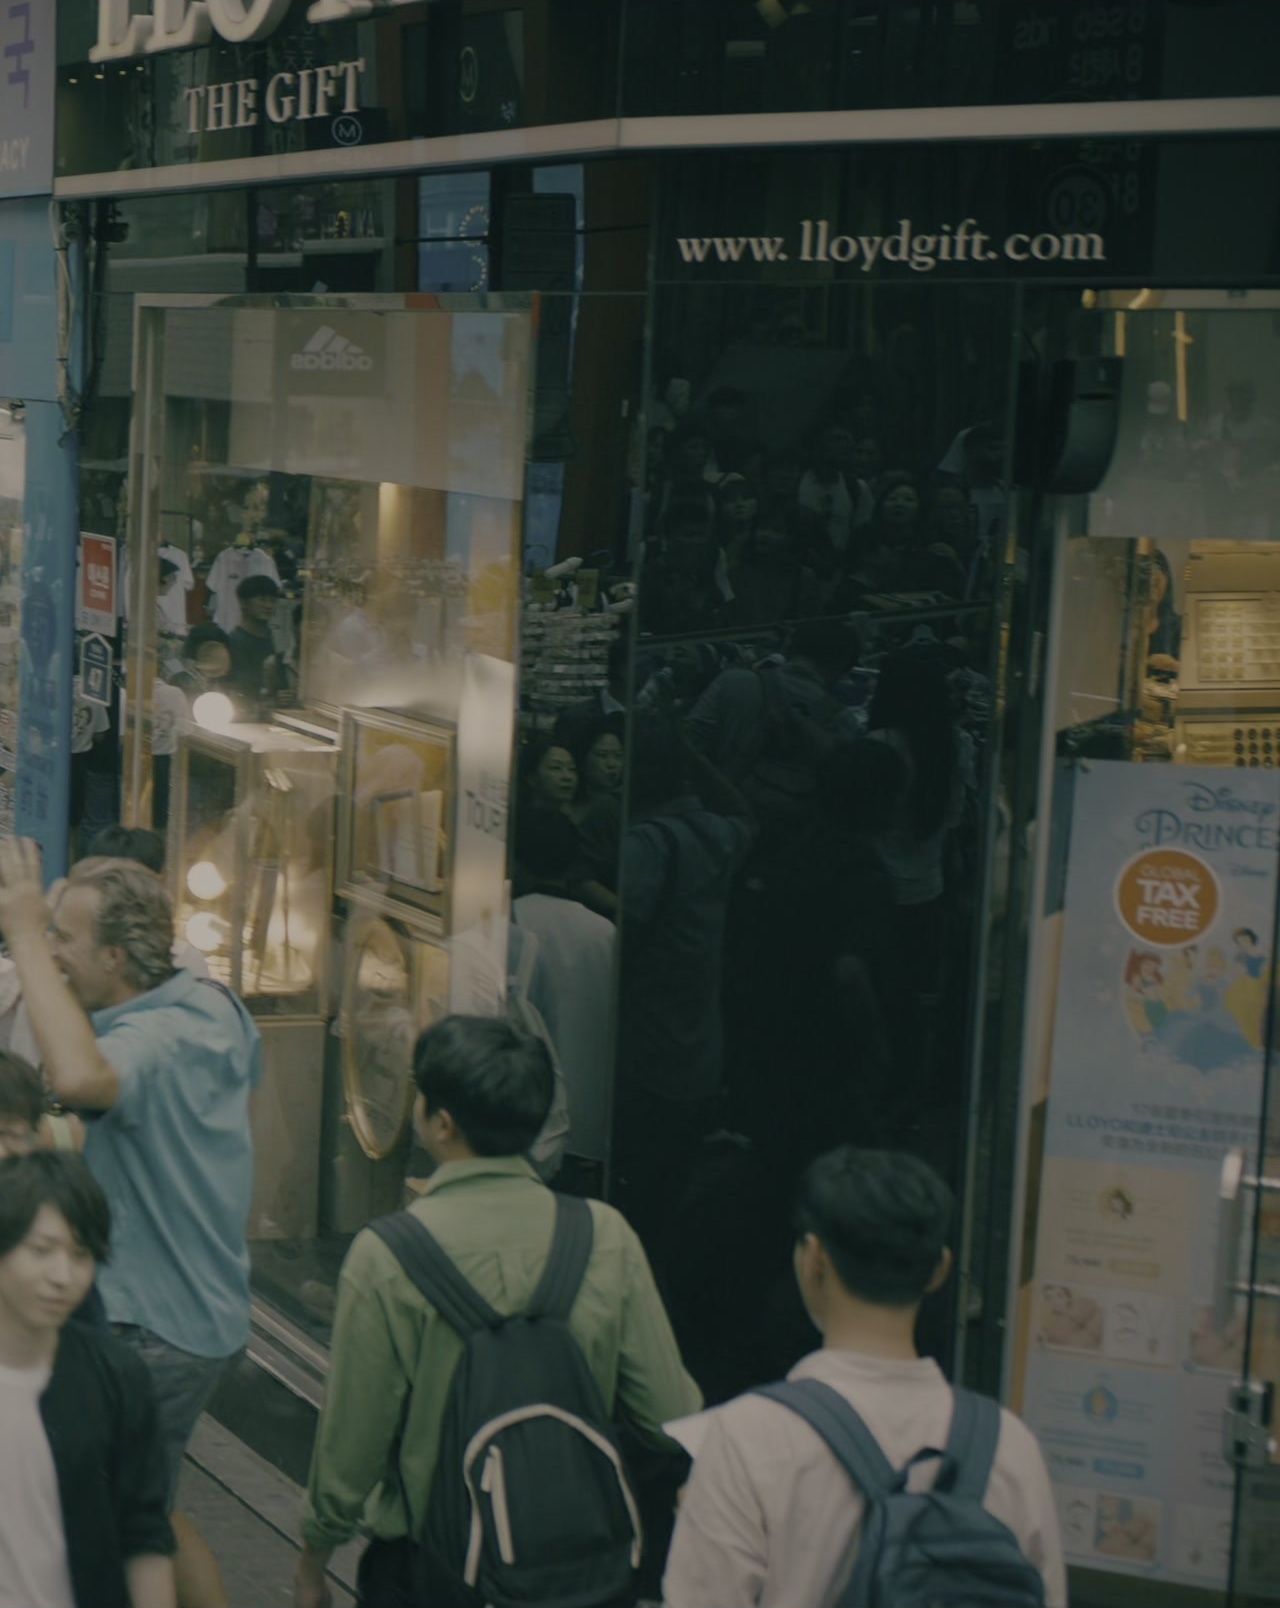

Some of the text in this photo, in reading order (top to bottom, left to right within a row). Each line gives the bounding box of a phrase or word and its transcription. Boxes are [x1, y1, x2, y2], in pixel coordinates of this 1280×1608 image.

[183, 57, 367, 134] THE GIFT
[677, 219, 1106, 271] www.lloydgift.com
[1136, 879, 1201, 909] TAX
[1137, 905, 1199, 930] FREE
